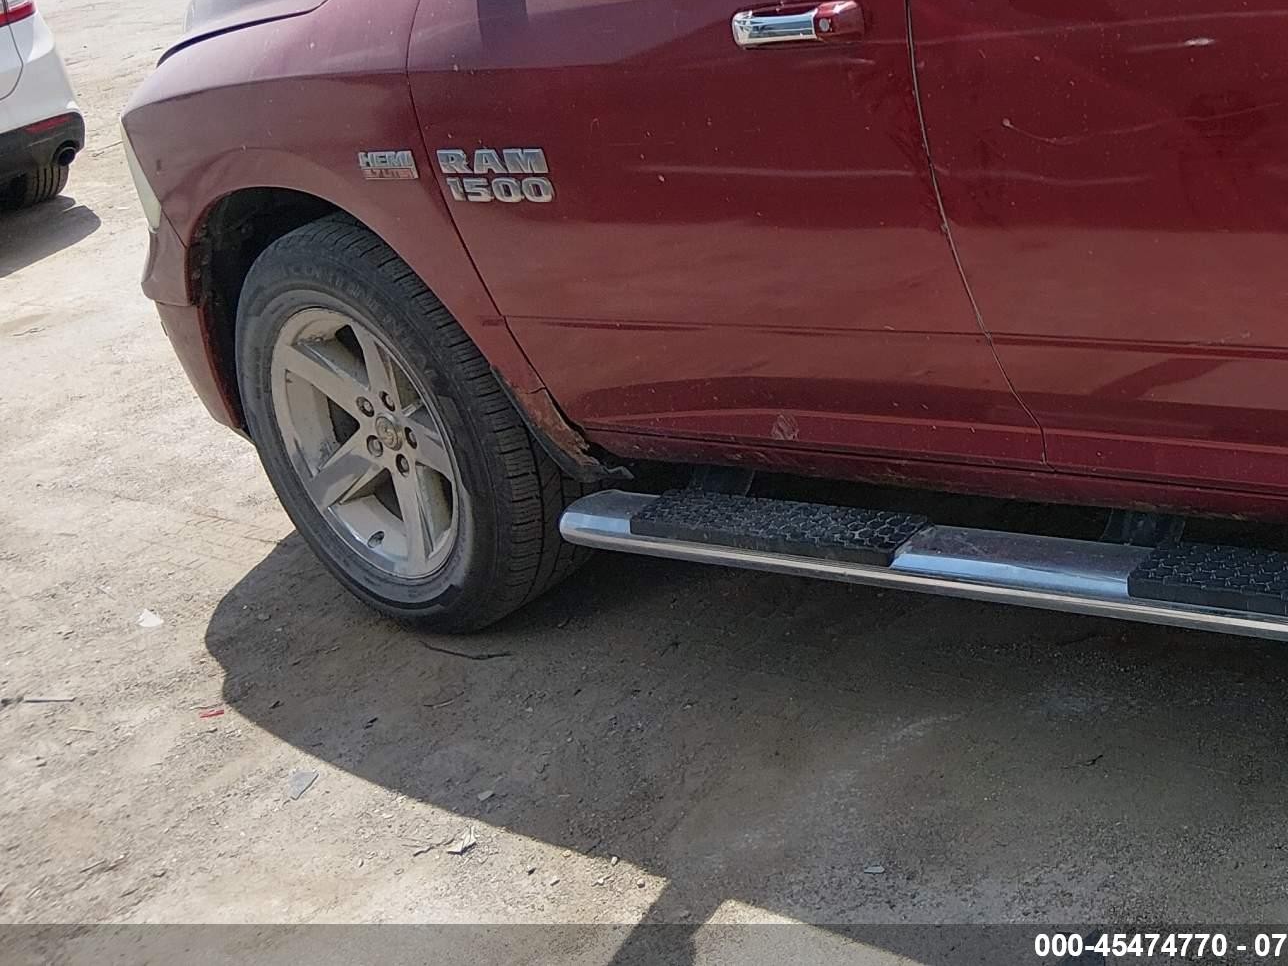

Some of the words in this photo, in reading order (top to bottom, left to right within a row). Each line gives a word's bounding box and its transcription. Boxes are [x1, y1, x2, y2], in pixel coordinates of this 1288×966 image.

[358, 151, 414, 168] HEMI
[437, 149, 549, 174] RAM
[446, 177, 554, 202] 1500
